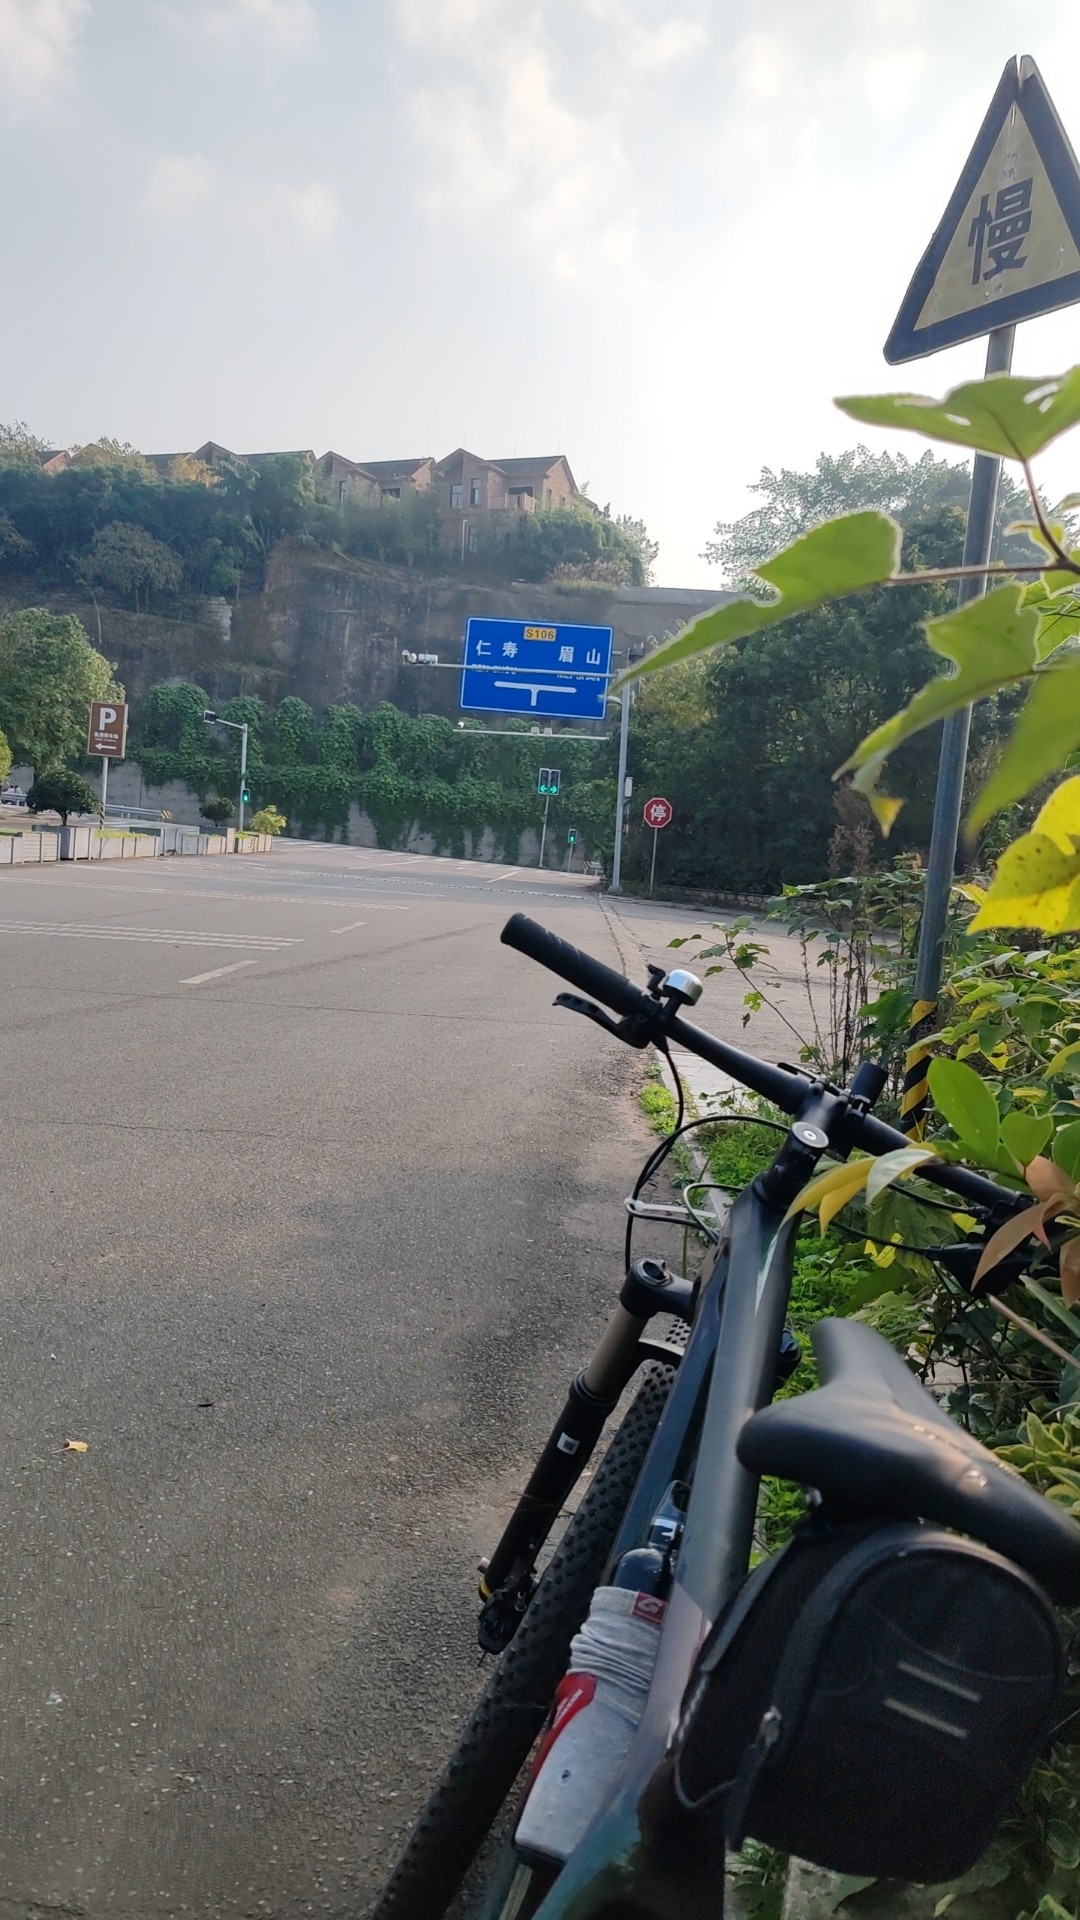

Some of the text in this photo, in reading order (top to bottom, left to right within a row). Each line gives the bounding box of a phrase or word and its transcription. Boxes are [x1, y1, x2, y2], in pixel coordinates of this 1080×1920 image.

[967, 177, 1034, 286] 慢
[525, 628, 555, 640] S106
[475, 639, 519, 659] 仁寿
[558, 645, 602, 666] 眉山
[98, 707, 117, 731] P
[649, 803, 667, 822] 停
